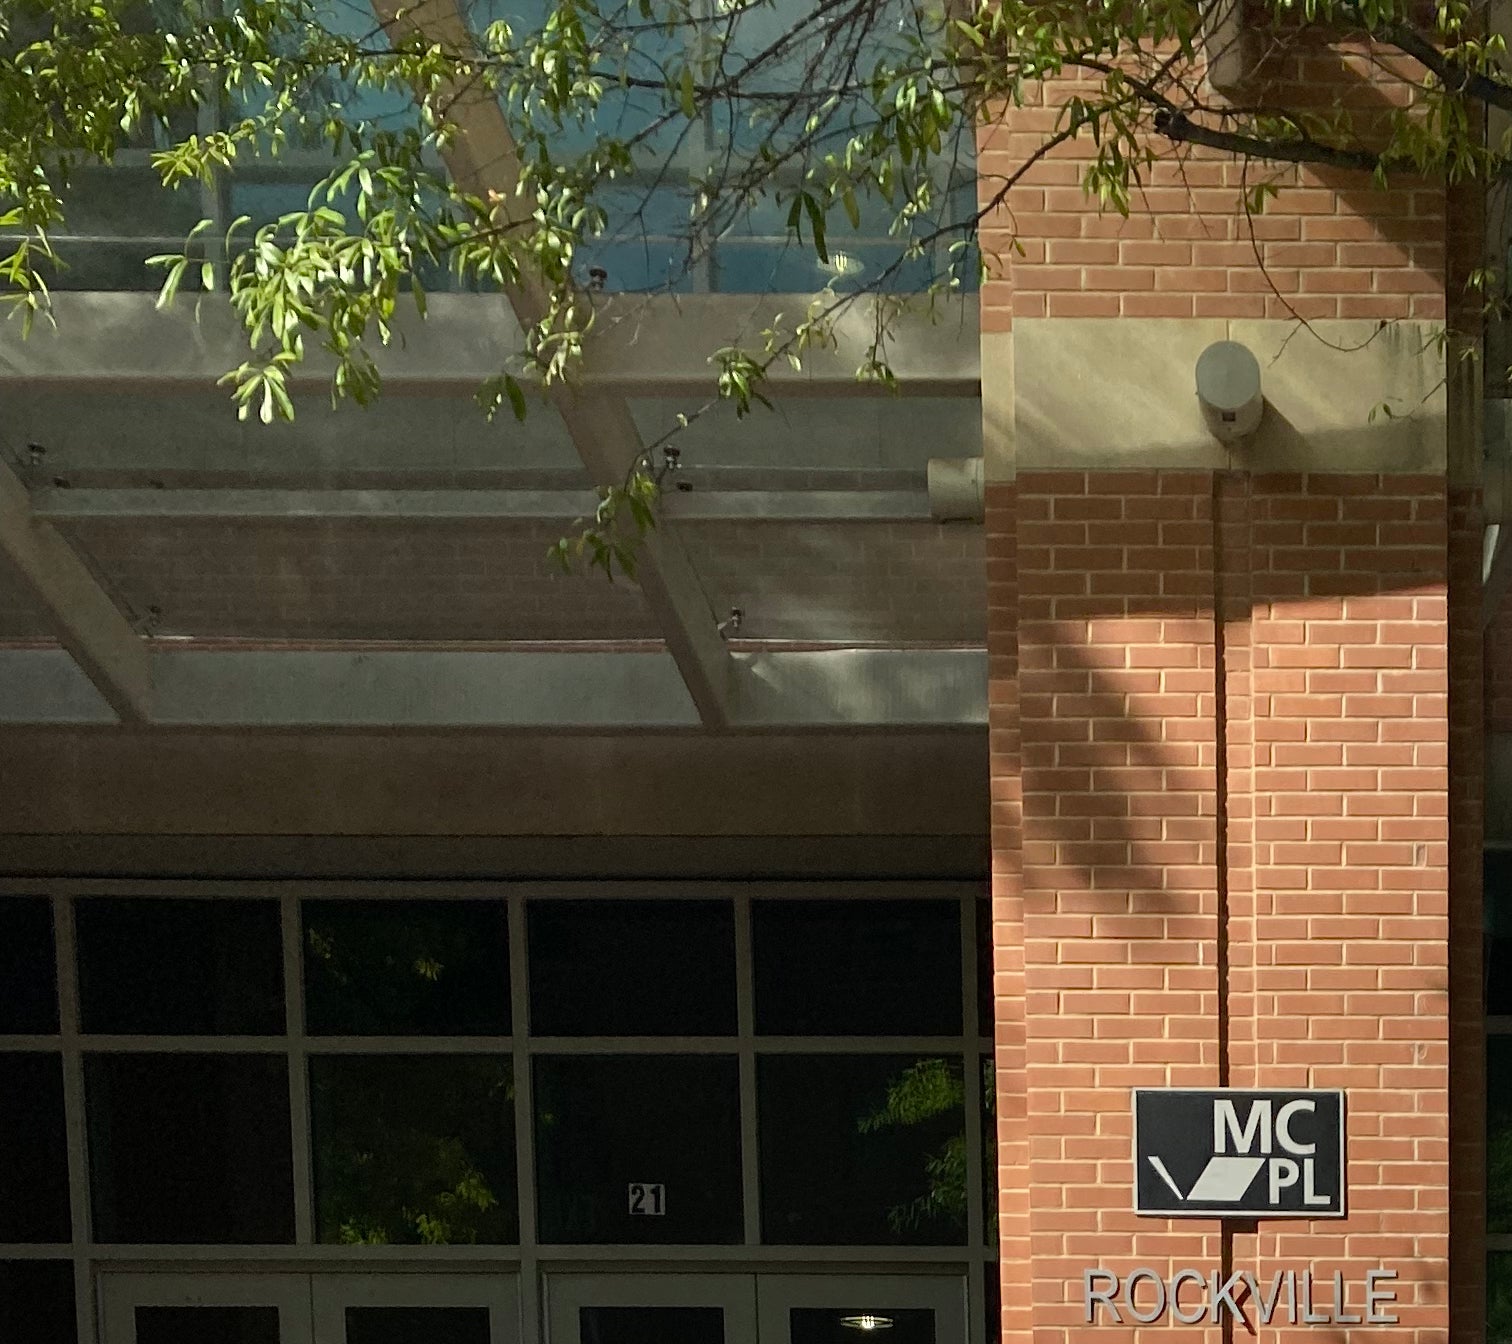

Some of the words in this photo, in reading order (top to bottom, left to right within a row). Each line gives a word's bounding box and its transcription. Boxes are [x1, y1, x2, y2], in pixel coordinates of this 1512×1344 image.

[1214, 1100, 1316, 1155] MC
[632, 1186, 661, 1213] 21
[1269, 1158, 1330, 1205] PL
[1084, 1268, 1398, 1324] ROCKVILLE
